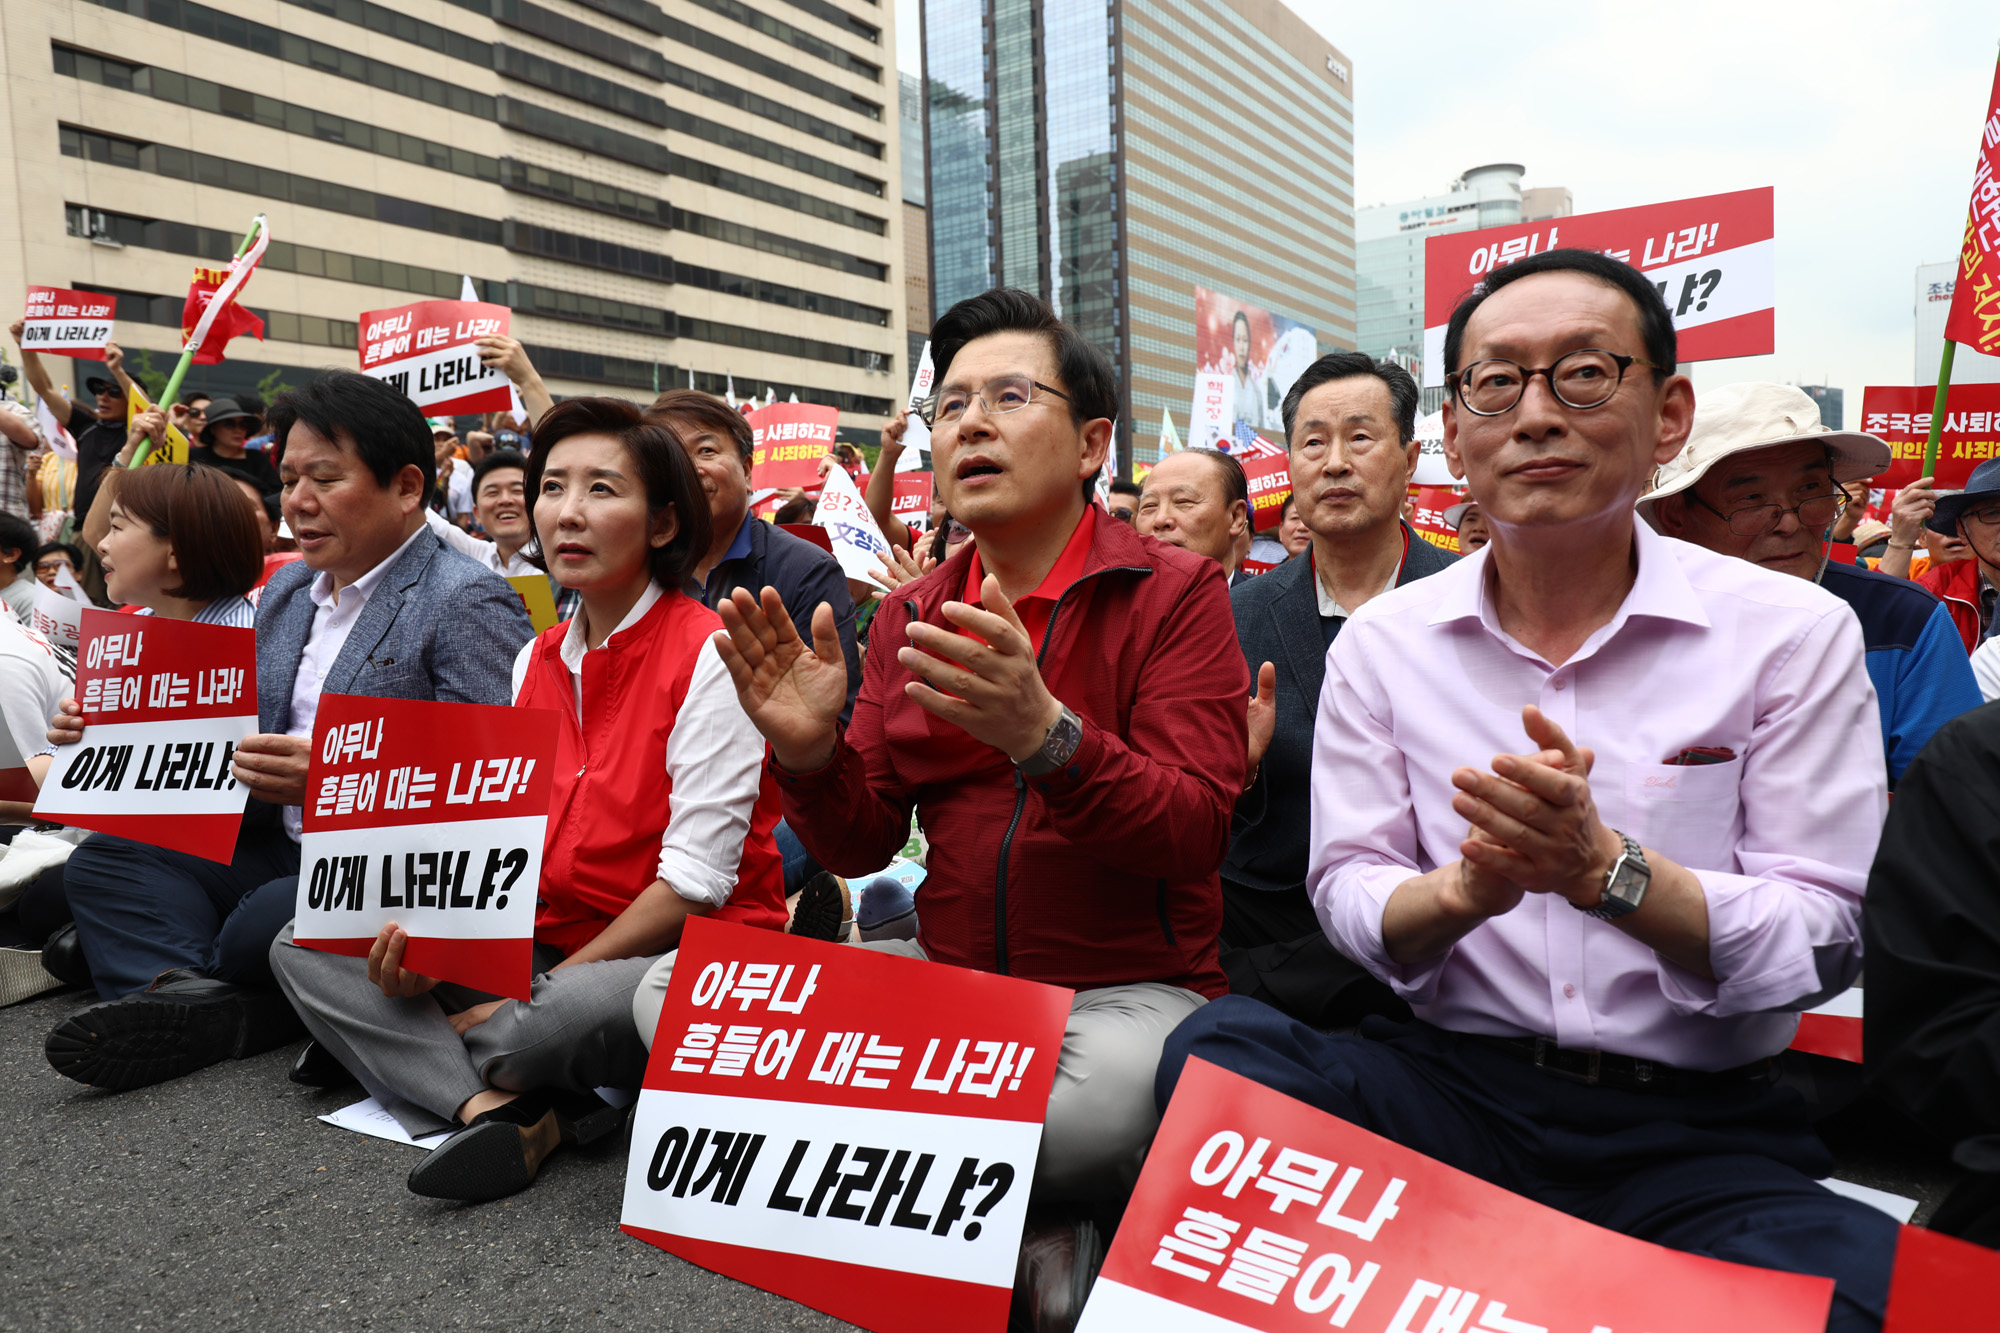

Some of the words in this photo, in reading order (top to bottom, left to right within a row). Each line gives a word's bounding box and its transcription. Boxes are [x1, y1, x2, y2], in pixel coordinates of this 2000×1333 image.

[1469, 226, 1558, 276] 아무나
[1641, 222, 1720, 268] 나라!
[26, 326, 52, 341] 이게
[55, 326, 109, 341] 나라냐?
[364, 333, 412, 364] 흔들어
[416, 325, 450, 350] 대는
[455, 318, 501, 341] 나라!
[366, 311, 412, 342] 아무나
[380, 370, 409, 397] 게
[766, 422, 831, 442] 사퇴하고
[1865, 412, 1934, 435] 조국은
[770, 444, 829, 462] 사죄하라
[816, 491, 852, 512] 정?
[890, 494, 922, 512] 나라!
[86, 631, 143, 670] 아무나
[82, 675, 143, 713] 흔들어
[148, 672, 190, 709] 대는
[196, 667, 245, 706] 나라!
[322, 717, 385, 765] 아무나
[61, 744, 134, 792] 이게
[315, 770, 380, 817] 흔들어
[383, 766, 437, 810] 대는
[446, 756, 536, 805] 나라!
[308, 855, 368, 912] 이게
[380, 848, 529, 911] 나라냐?
[691, 961, 822, 1014] 아무나
[670, 1022, 806, 1081] 흔들어
[807, 1031, 904, 1089] 대는
[910, 1037, 1036, 1099] 나라!
[646, 1126, 767, 1207] 이게
[766, 1138, 1016, 1242] 나라냐?
[1190, 1130, 1407, 1242] 아무나
[1151, 1206, 1381, 1329] 흔들어
